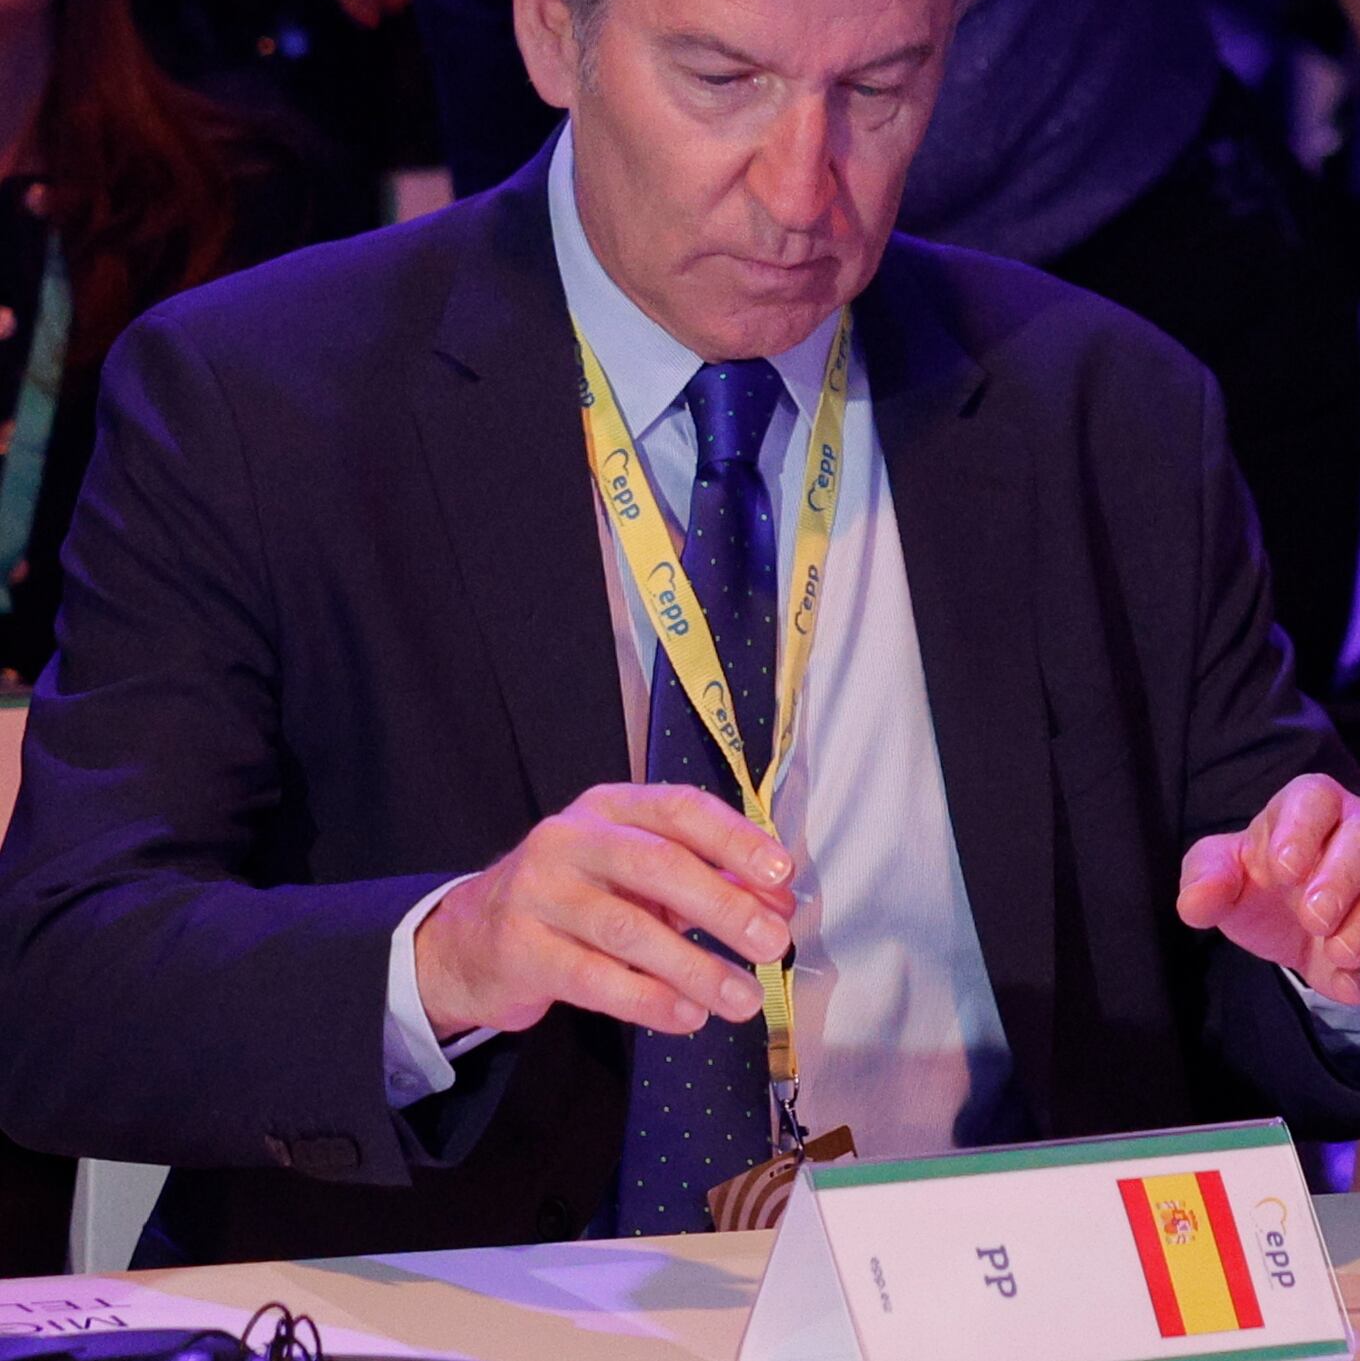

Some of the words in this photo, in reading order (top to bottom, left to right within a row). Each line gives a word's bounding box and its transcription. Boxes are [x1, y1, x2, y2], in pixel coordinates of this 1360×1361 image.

[818, 443, 840, 489] epp
[611, 473, 642, 522] epp
[658, 588, 691, 638] epp
[800, 564, 820, 614] epp
[715, 707, 745, 754] epp
[975, 1244, 1018, 1300] PP
[1265, 1229, 1296, 1289] epp
